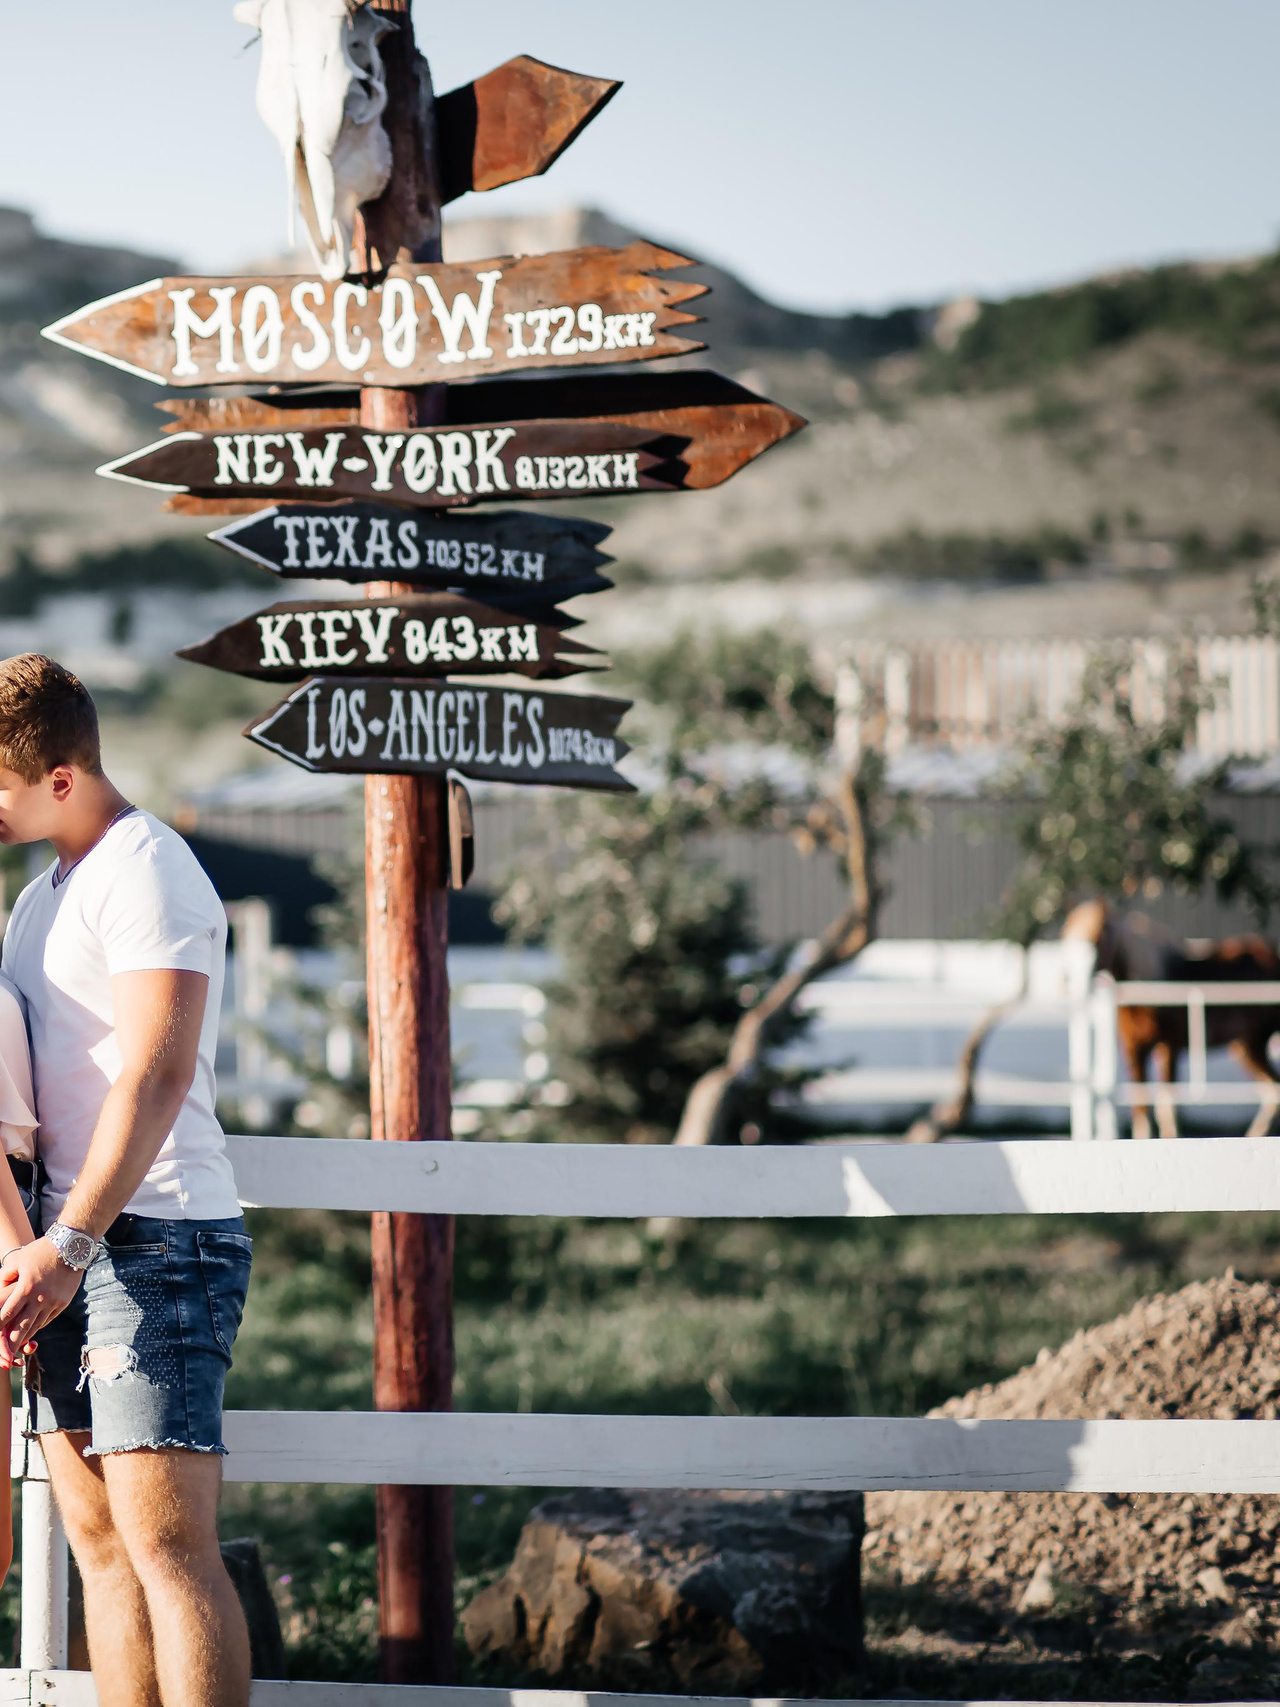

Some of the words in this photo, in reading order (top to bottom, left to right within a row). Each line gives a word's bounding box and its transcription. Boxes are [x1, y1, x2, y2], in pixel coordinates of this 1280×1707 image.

[168, 270, 503, 377] MOSCOW
[213, 428, 517, 495] NEW-YORK
[274, 516, 420, 569] TEXAS
[257, 607, 399, 668] KIEV
